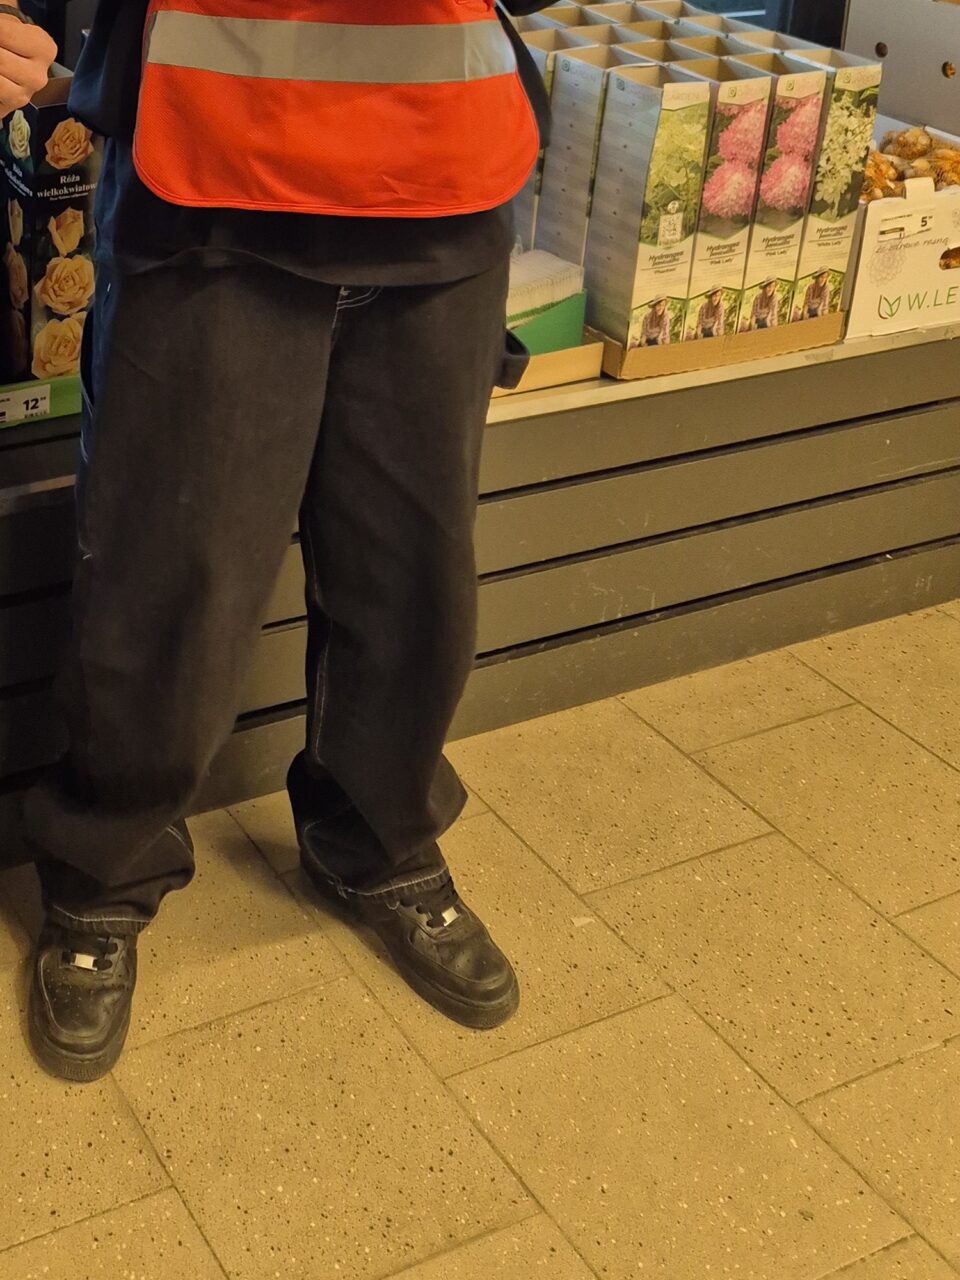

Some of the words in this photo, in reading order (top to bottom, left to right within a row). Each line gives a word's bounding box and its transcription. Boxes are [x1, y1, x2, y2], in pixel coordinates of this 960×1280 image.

[60, 174, 80, 184] Róża
[36, 183, 97, 198] wielkokwiatow
[920, 215, 928, 227] 5
[706, 242, 740, 252] Hydrangea
[648, 251, 684, 262] Hydrangea
[907, 285, 959, 311] W.LE
[23, 398, 39, 411] 12
